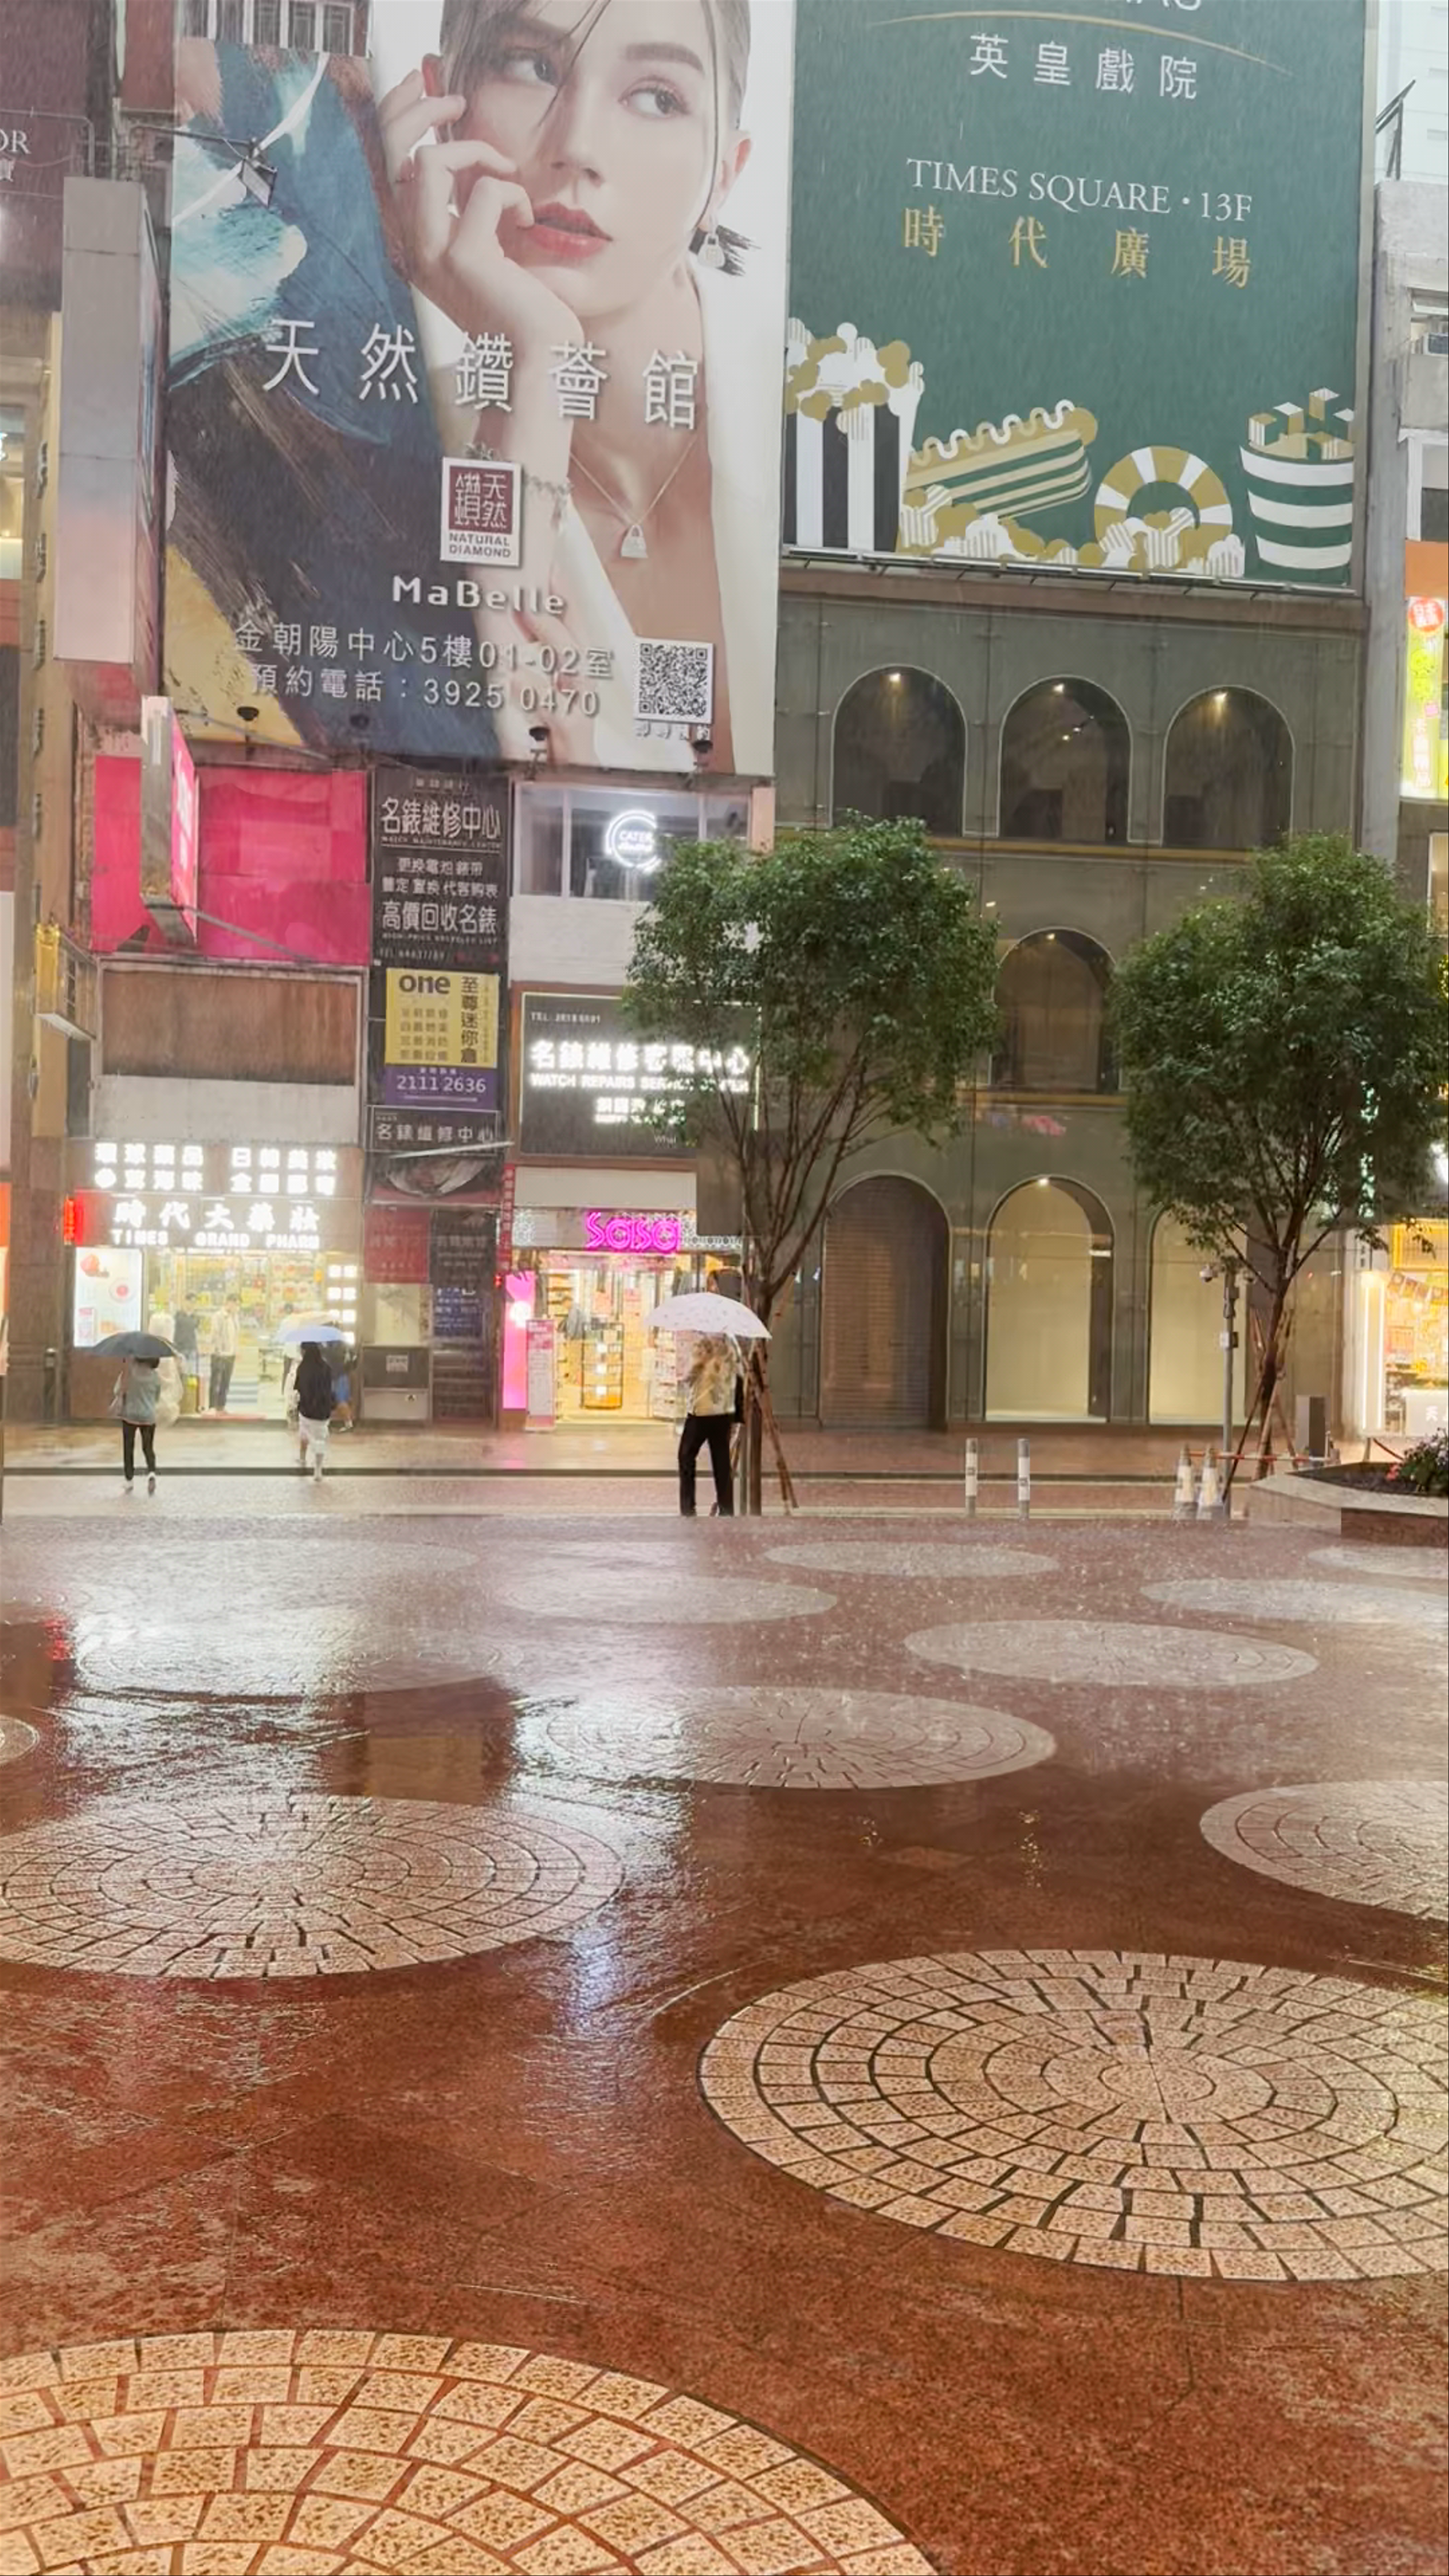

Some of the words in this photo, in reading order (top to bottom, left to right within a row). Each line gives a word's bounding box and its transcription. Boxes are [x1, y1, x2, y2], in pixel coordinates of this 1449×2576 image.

[969, 32, 1198, 100] 英皇戲院
[906, 158, 1018, 197] TIMES
[1029, 172, 1171, 214] SQUARE
[1201, 191, 1252, 222] 13F
[902, 205, 1251, 289] 時代廣場
[262, 318, 698, 430] 天然鑽薈館
[449, 532, 509, 547] NATURAL
[449, 545, 511, 558] DIAMOND
[393, 575, 565, 615] MaBelle
[234, 621, 613, 679] 金朝陽中心5樓01-02室
[380, 796, 501, 840] 名錶維修中心
[381, 899, 497, 934] 高價回收名錶
[399, 975, 451, 994] one
[397, 1075, 439, 1091] 2111
[443, 1077, 486, 1093] 2636
[531, 1073, 576, 1087] WATCH
[581, 1074, 635, 1089] REPAIRS
[111, 1229, 168, 1245] TIMES
[195, 1231, 250, 1248] GRAND
[266, 1233, 320, 1250] PHARM
